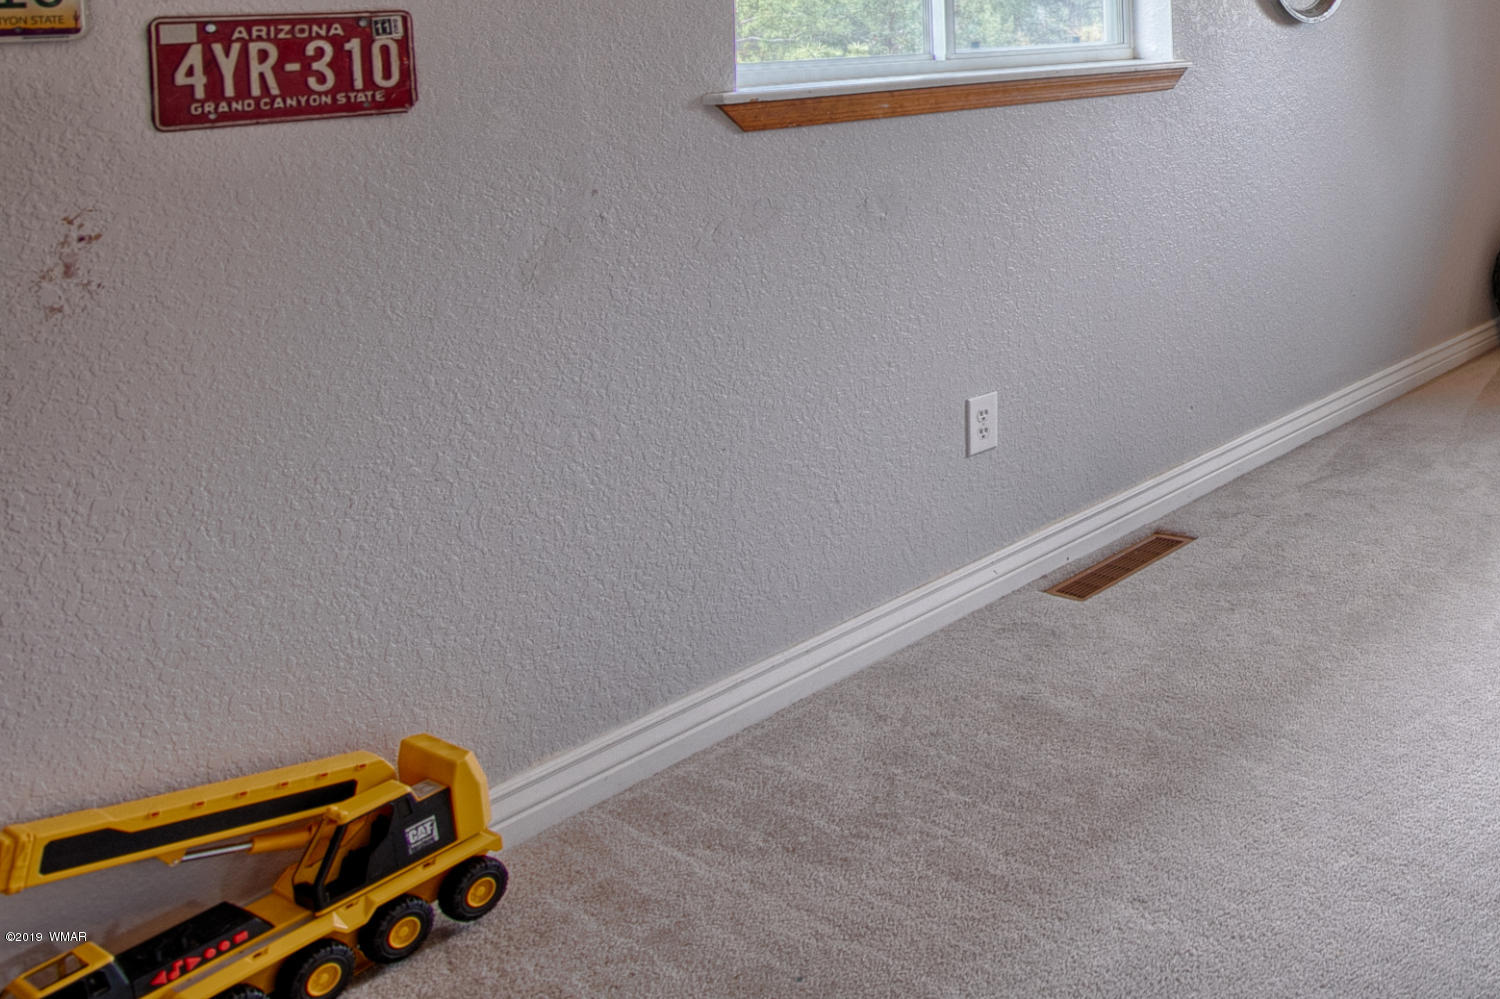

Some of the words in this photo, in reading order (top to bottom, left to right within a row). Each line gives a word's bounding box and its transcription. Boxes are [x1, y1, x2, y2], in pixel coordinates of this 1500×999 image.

[31, 14, 65, 25] STATE
[232, 23, 345, 41] ARIZONA
[174, 38, 401, 100] 4YR-310
[190, 99, 256, 115] GRAND
[260, 94, 332, 109] CANYON
[336, 90, 386, 103] STATE
[408, 821, 434, 844] CAT
